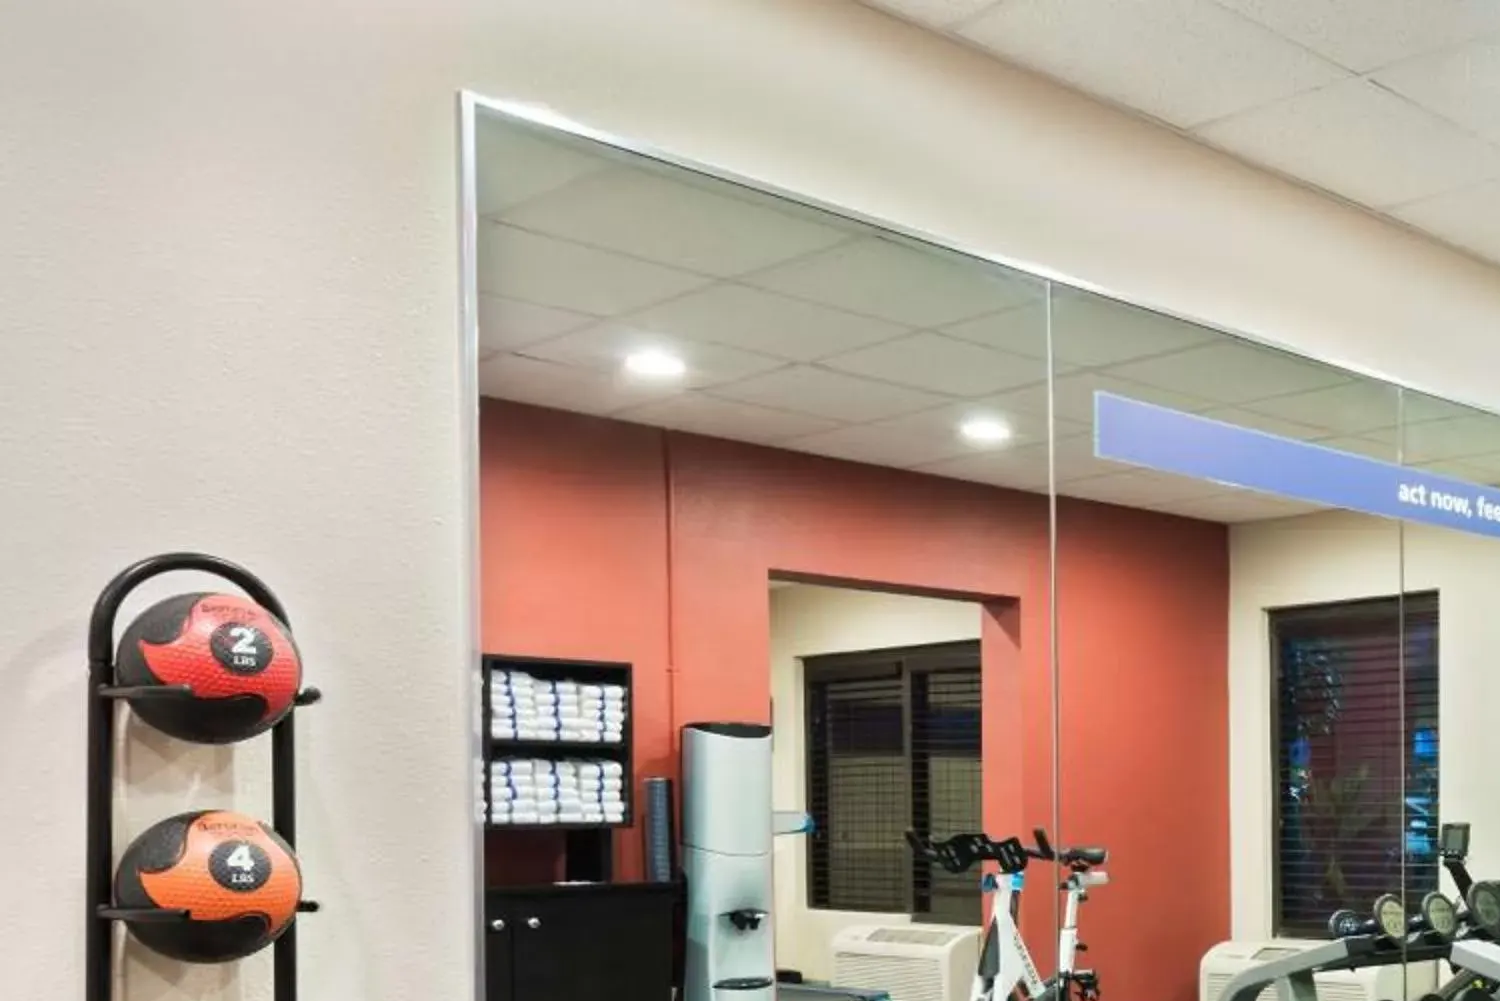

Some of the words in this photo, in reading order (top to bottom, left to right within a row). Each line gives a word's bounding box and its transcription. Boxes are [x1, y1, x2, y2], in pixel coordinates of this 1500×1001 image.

[1398, 483, 1427, 505] act
[1431, 491, 1473, 519] now,
[229, 626, 257, 655] 2
[226, 844, 255, 872] 4
